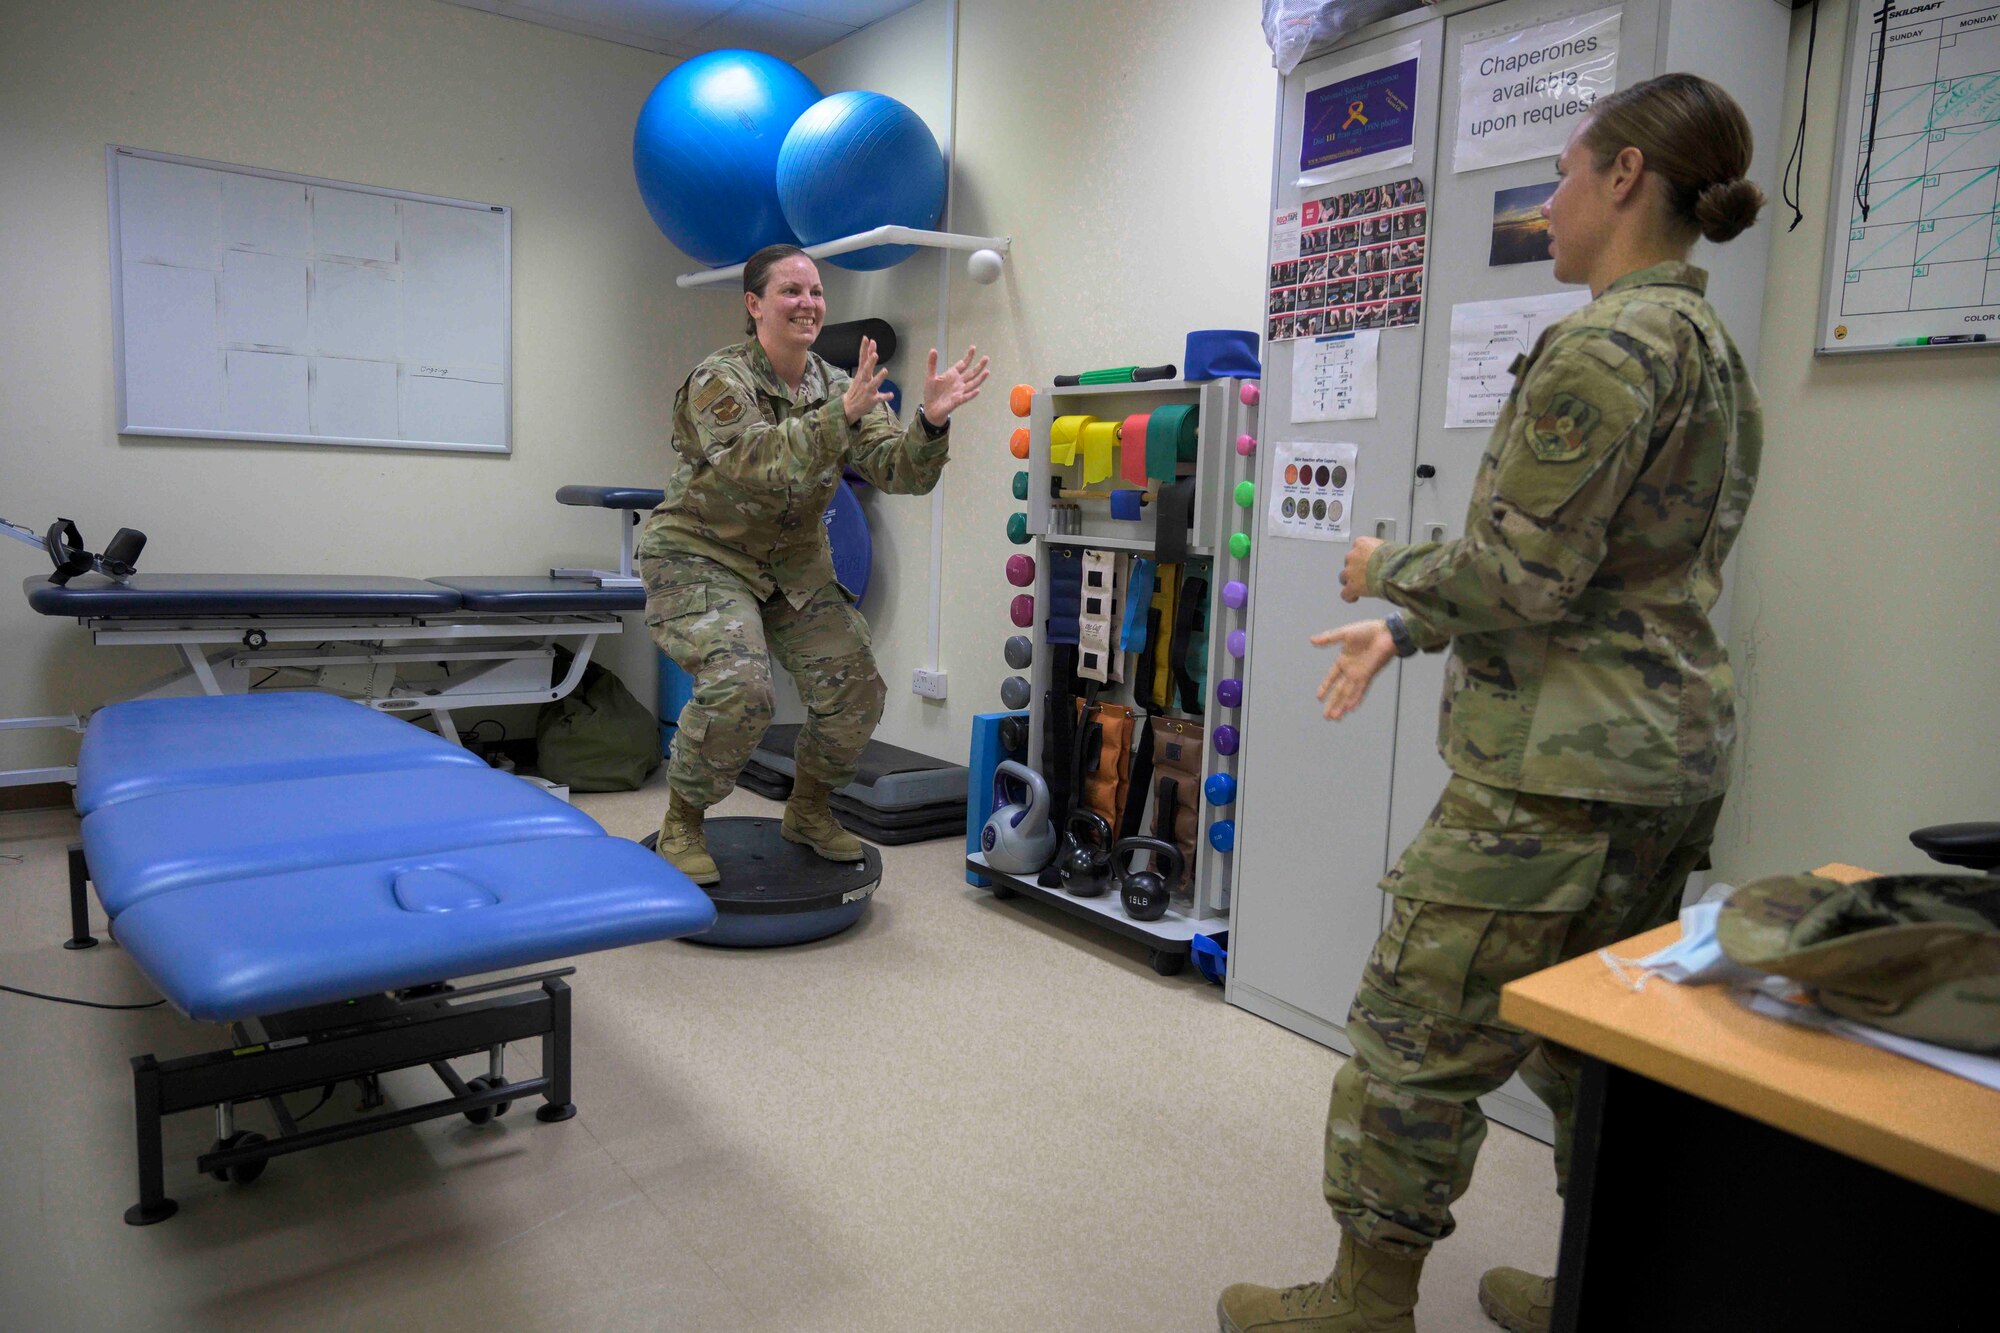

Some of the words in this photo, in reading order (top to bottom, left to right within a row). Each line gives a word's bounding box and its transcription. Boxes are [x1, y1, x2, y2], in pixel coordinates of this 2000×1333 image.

[1889, 1, 1944, 19] SKILCRAFT
[1889, 30, 1924, 42] SUNDAY
[1959, 14, 1998, 27] MONDAY
[1480, 36, 1598, 76] Chaperones
[1492, 71, 1578, 102] available
[1471, 114, 1516, 138] upon
[1523, 93, 1597, 124] request
[1920, 222, 1934, 232] 24
[1964, 314, 1995, 322] COLOR
